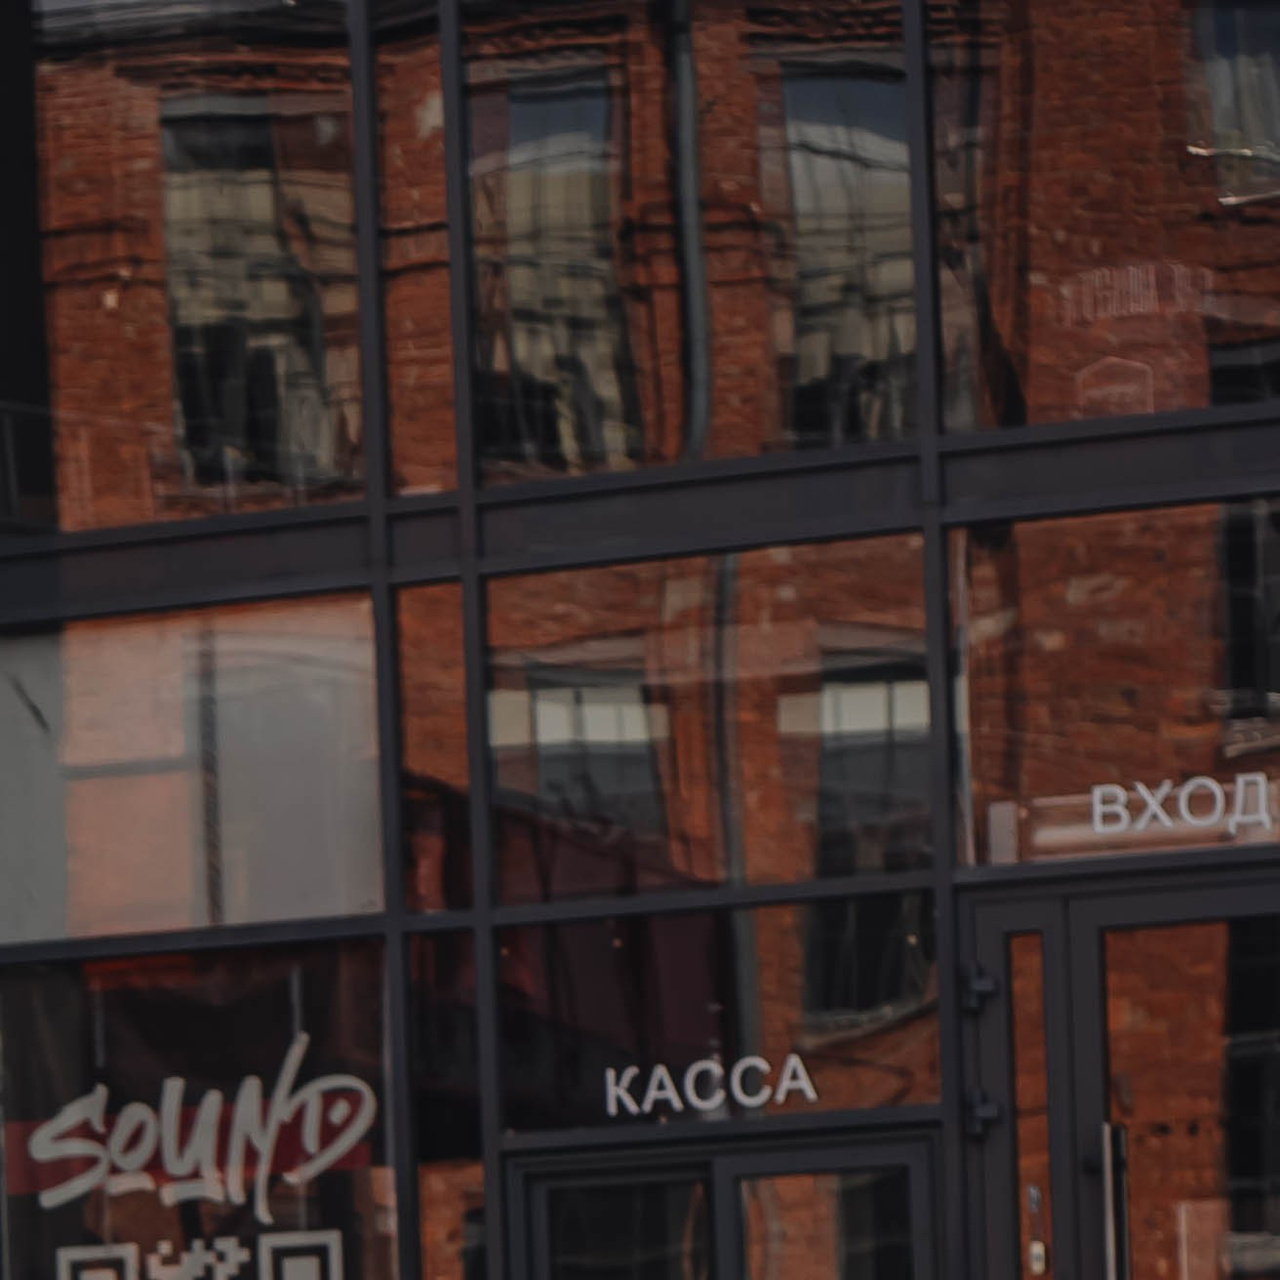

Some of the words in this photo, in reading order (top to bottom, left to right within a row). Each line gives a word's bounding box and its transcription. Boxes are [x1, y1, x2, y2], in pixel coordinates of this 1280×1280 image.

[1091, 771, 1273, 835] ВХОД
[604, 1052, 819, 1116] КАССА
[26, 1029, 378, 1225] SOUND
